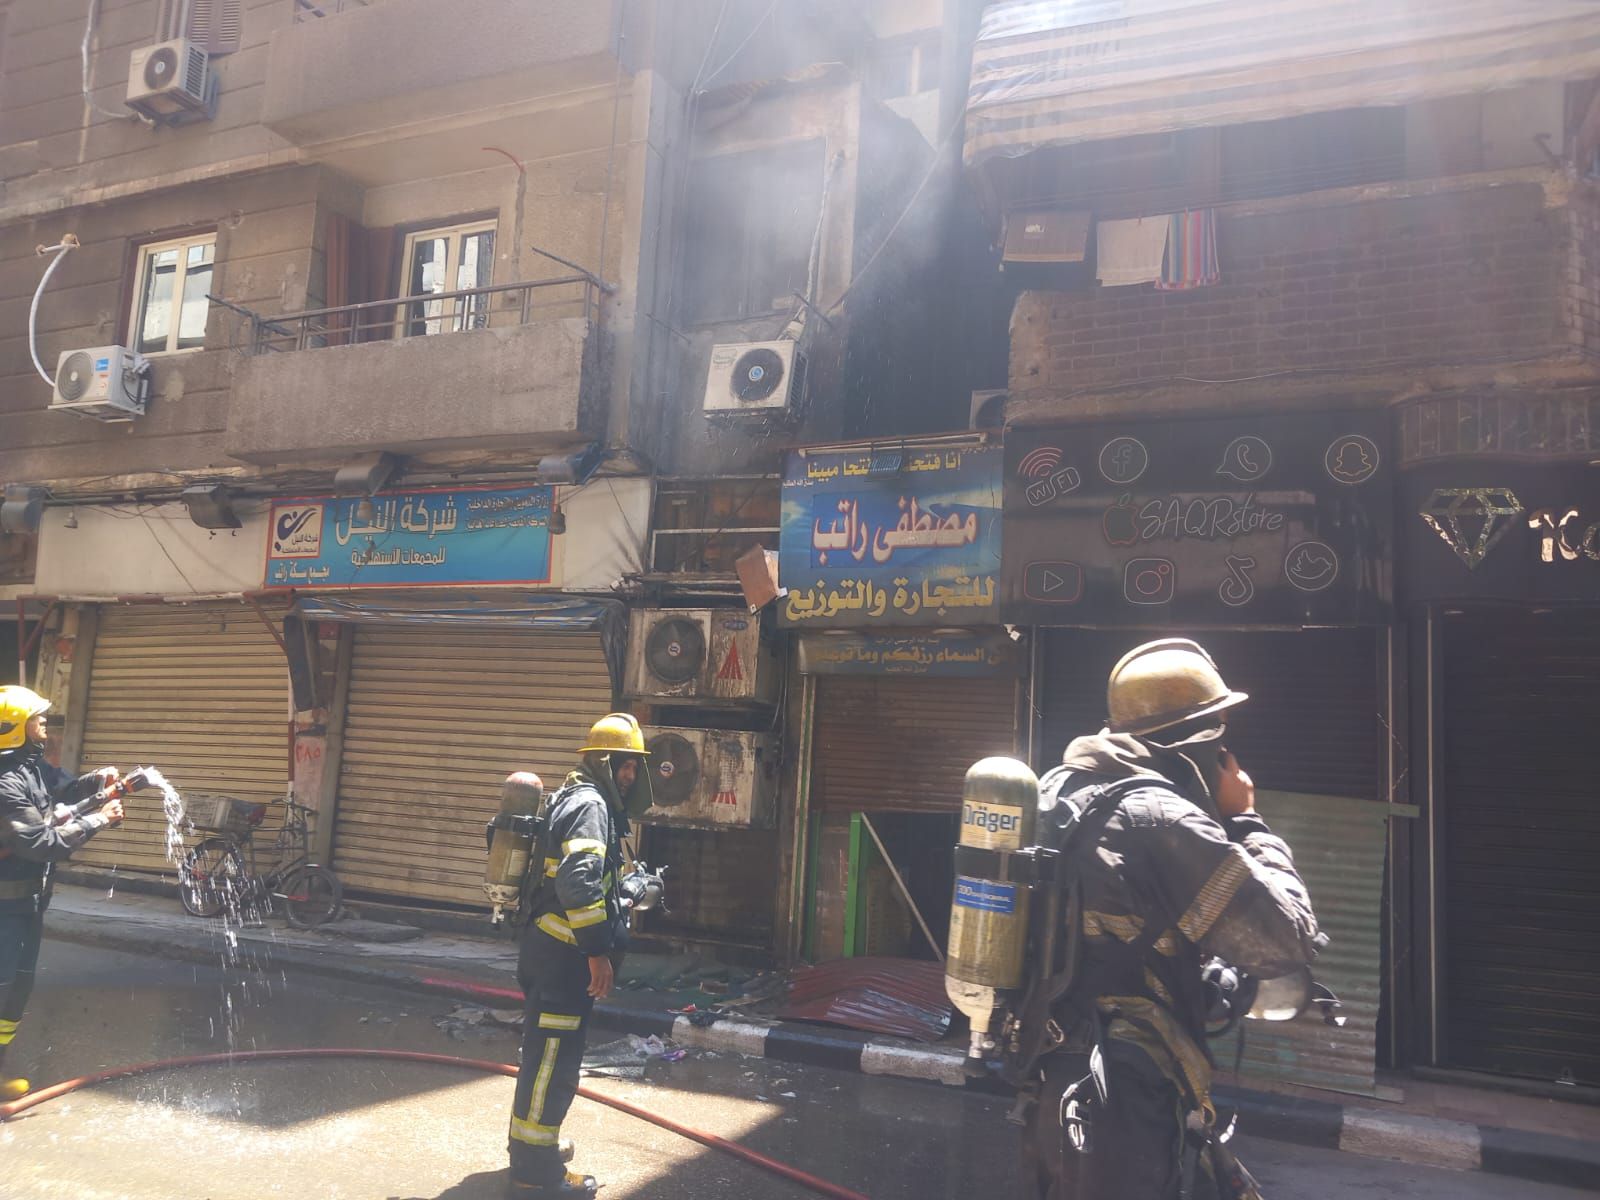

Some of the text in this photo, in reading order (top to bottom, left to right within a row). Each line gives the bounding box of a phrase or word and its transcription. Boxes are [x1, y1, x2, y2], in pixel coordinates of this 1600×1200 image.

[807, 462, 839, 482] مبينا
[336, 495, 457, 546] شركة النيل
[813, 496, 978, 565] مصطفى راتب
[351, 547, 401, 568] الاستهلكية
[786, 576, 996, 620] للتجارة والتوزيع
[882, 646, 934, 664] رزقكم
[936, 647, 985, 663] السماء
[962, 804, 1019, 833] Dräger
